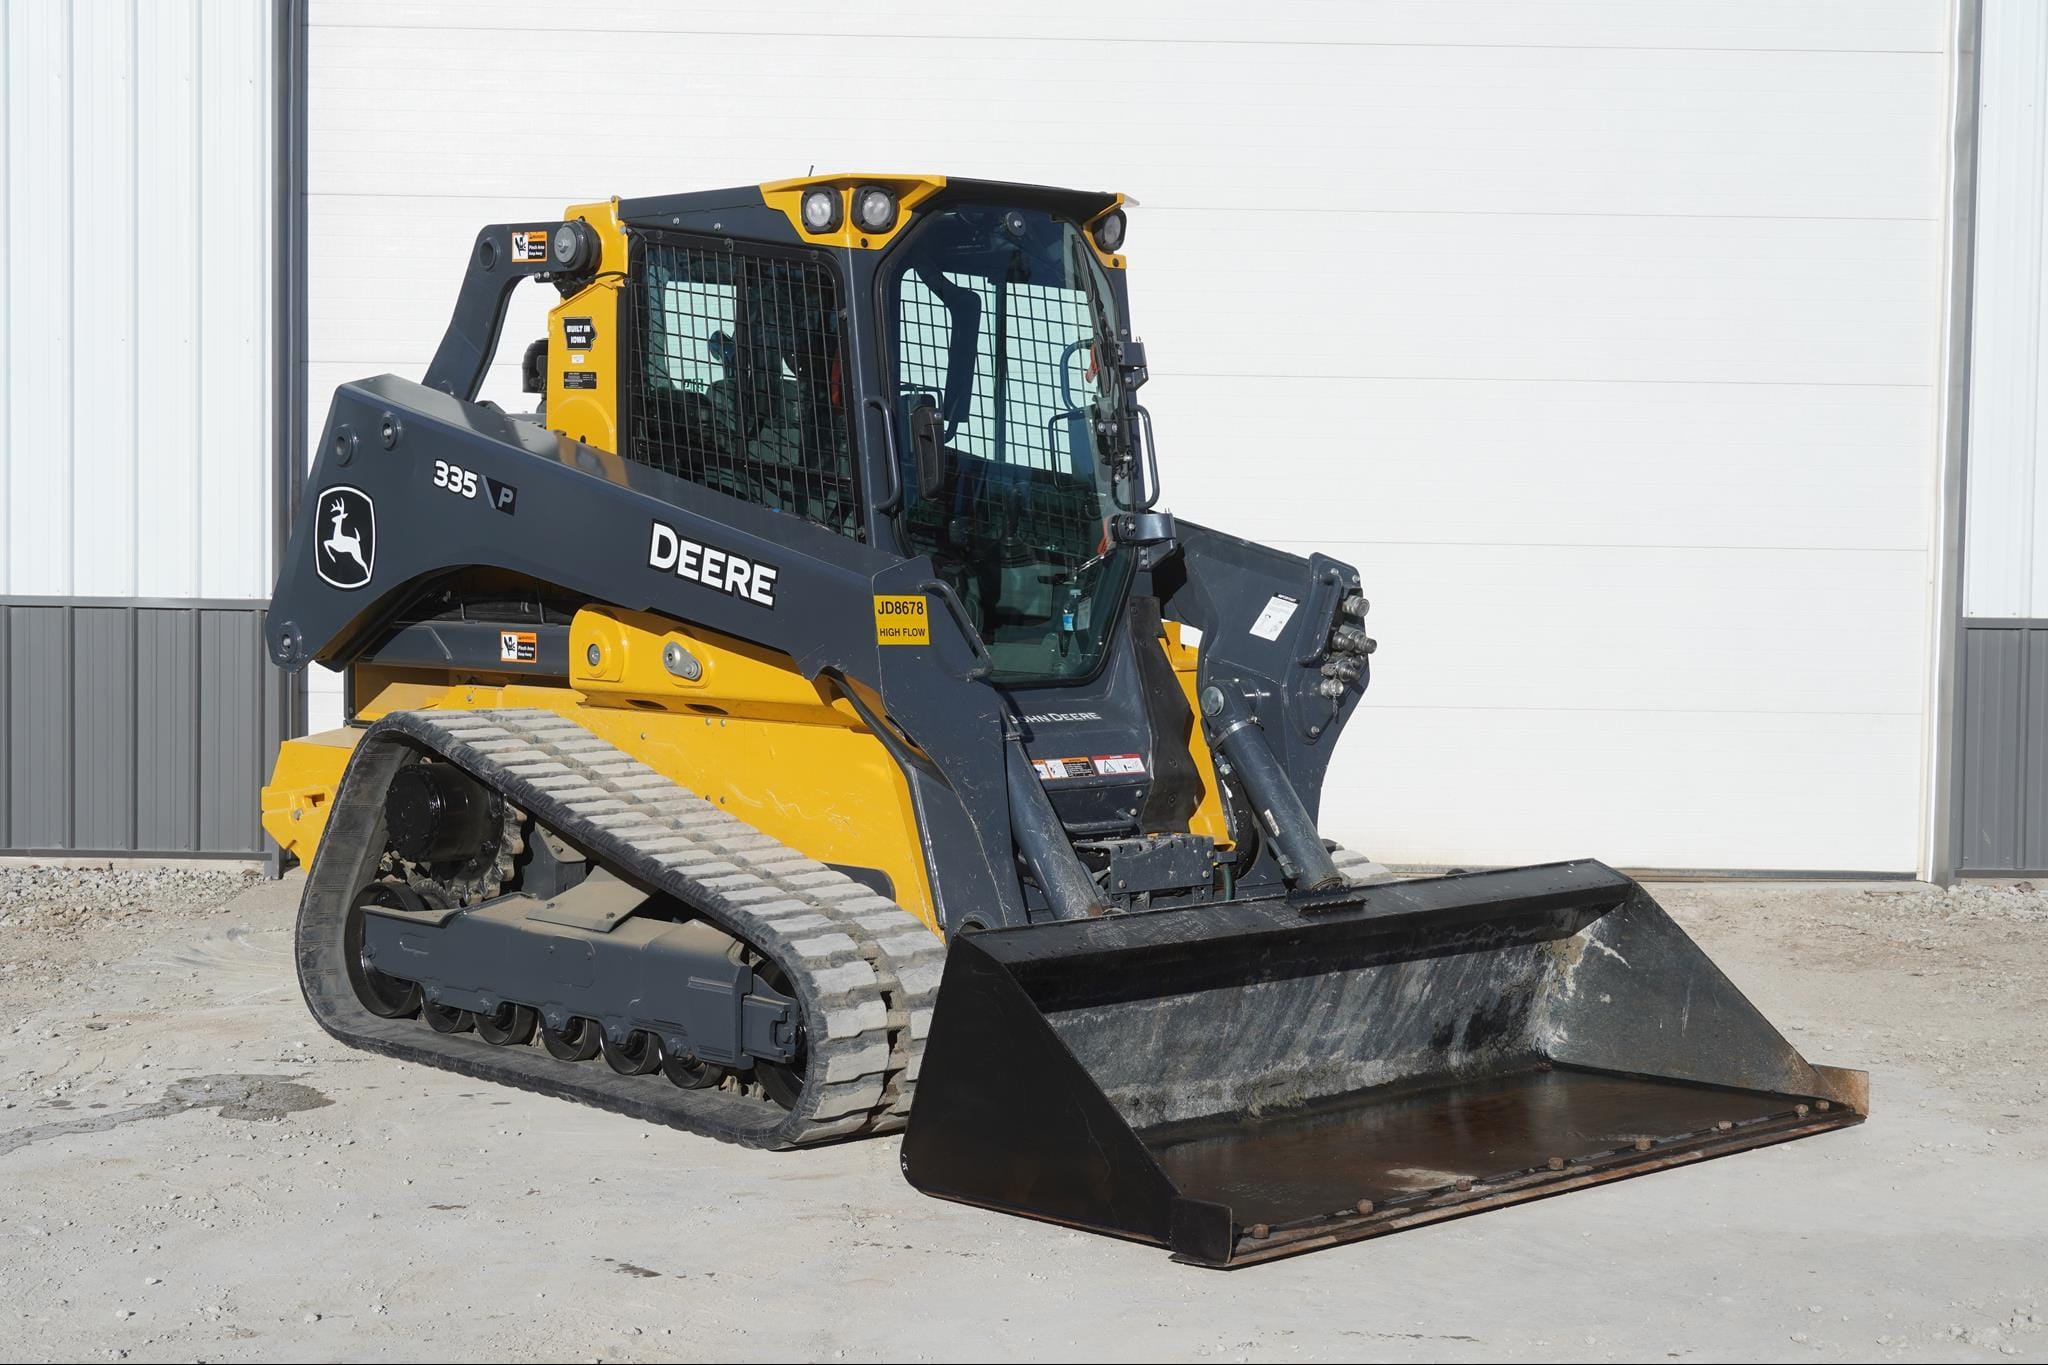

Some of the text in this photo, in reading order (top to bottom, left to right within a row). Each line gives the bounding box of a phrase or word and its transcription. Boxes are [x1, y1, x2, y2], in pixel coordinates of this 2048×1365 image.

[566, 325, 591, 333] BUILT IN
[570, 336, 586, 344] IOWA
[433, 459, 514, 508] 335 P
[649, 522, 778, 607] DEERE
[877, 601, 924, 615] JD8678
[879, 628, 926, 637] HIGH FLOW
[1048, 712, 1102, 722] DEERE
